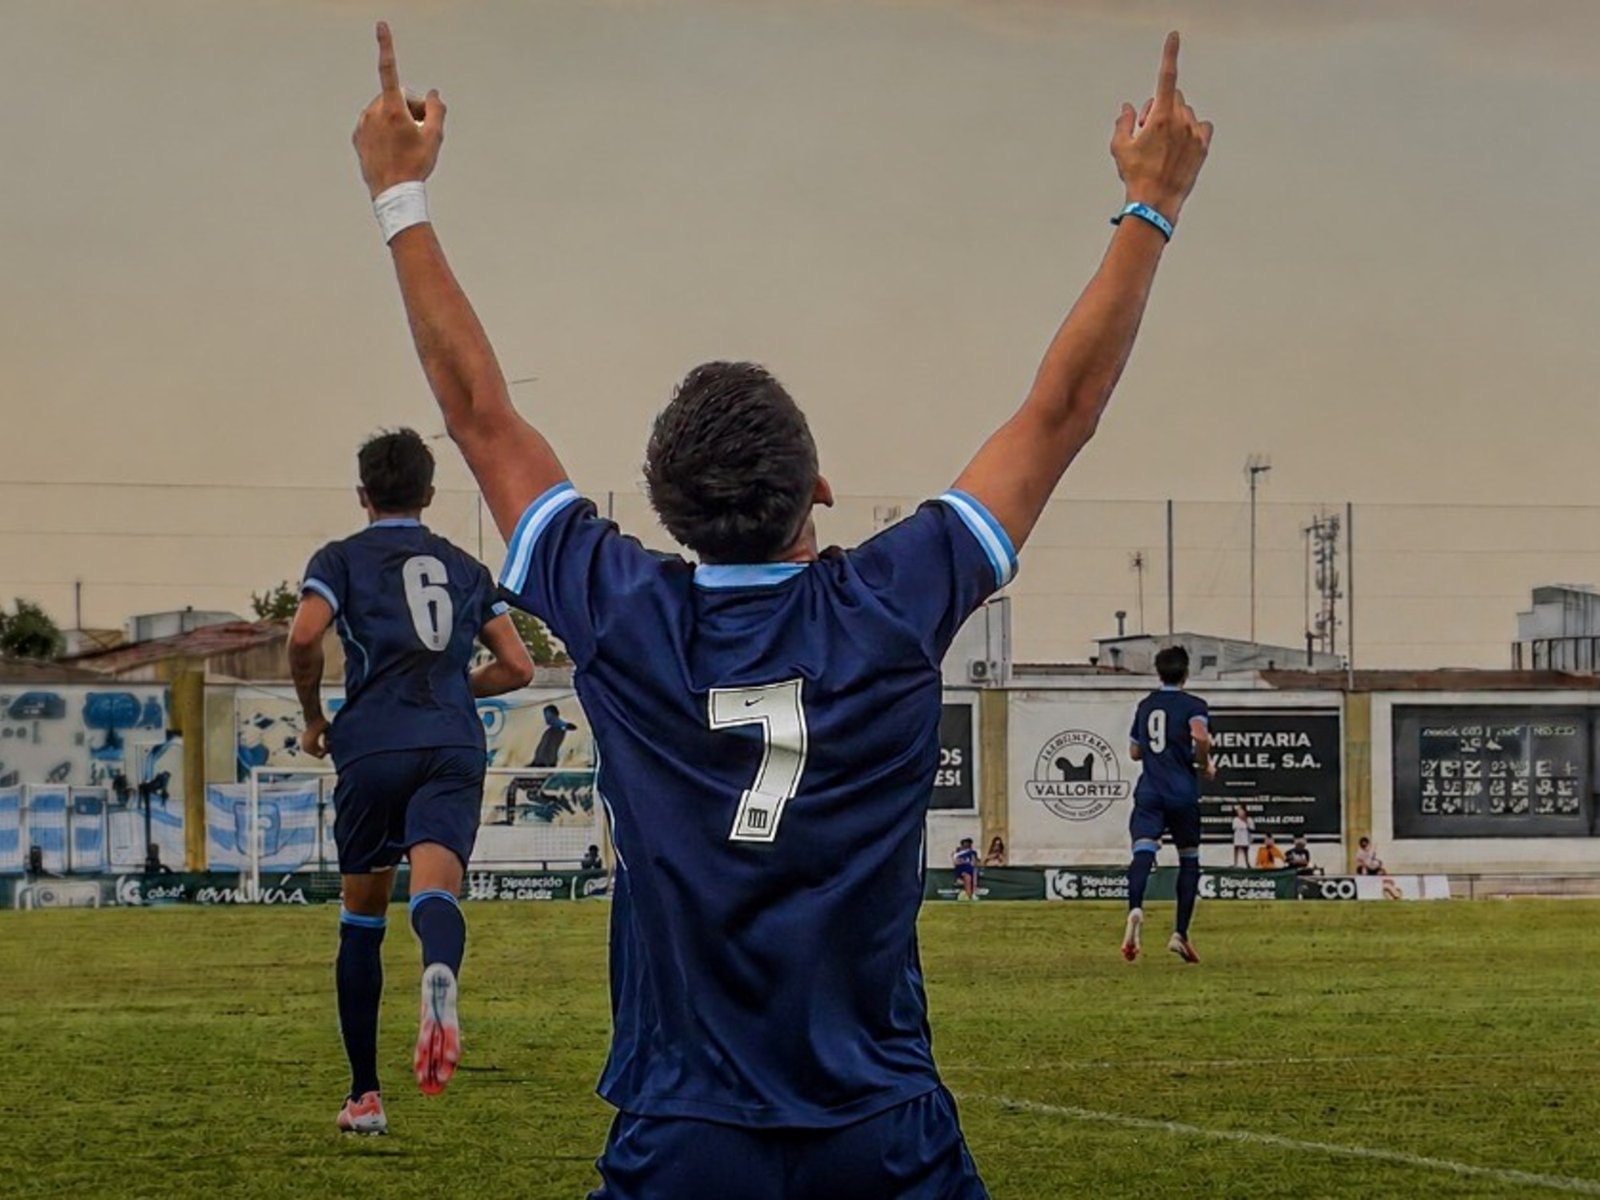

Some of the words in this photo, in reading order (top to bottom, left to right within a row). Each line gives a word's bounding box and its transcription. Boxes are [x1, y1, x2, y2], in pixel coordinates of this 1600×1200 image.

[402, 555, 453, 652] 6
[1148, 709, 1166, 753] 9
[708, 678, 807, 842] 7
[1282, 753, 1321, 768] S.A.
[1035, 784, 1122, 796] VALLORTIZ
